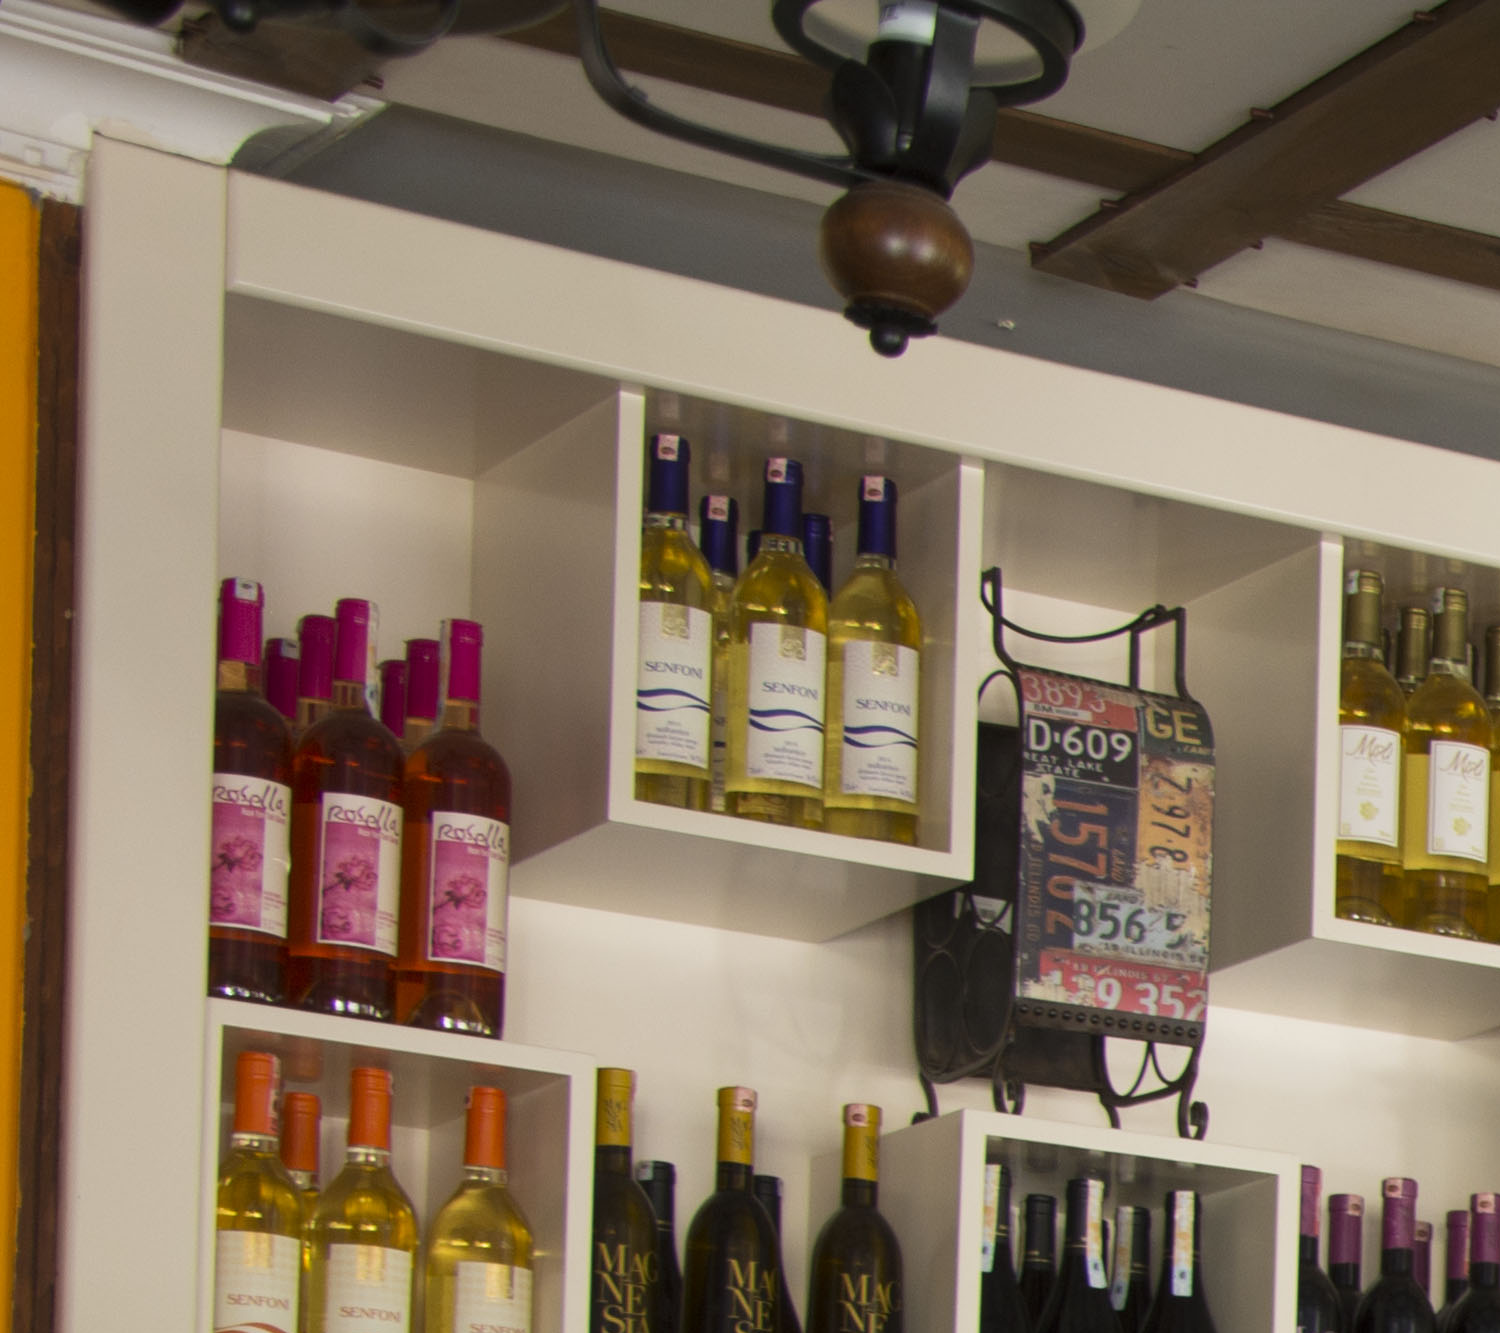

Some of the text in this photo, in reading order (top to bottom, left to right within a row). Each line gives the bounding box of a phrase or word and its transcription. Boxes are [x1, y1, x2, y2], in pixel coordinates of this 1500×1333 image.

[1146, 706, 1202, 745] GE
[1036, 764, 1081, 778] STATE
[728, 1259, 778, 1301] MA
